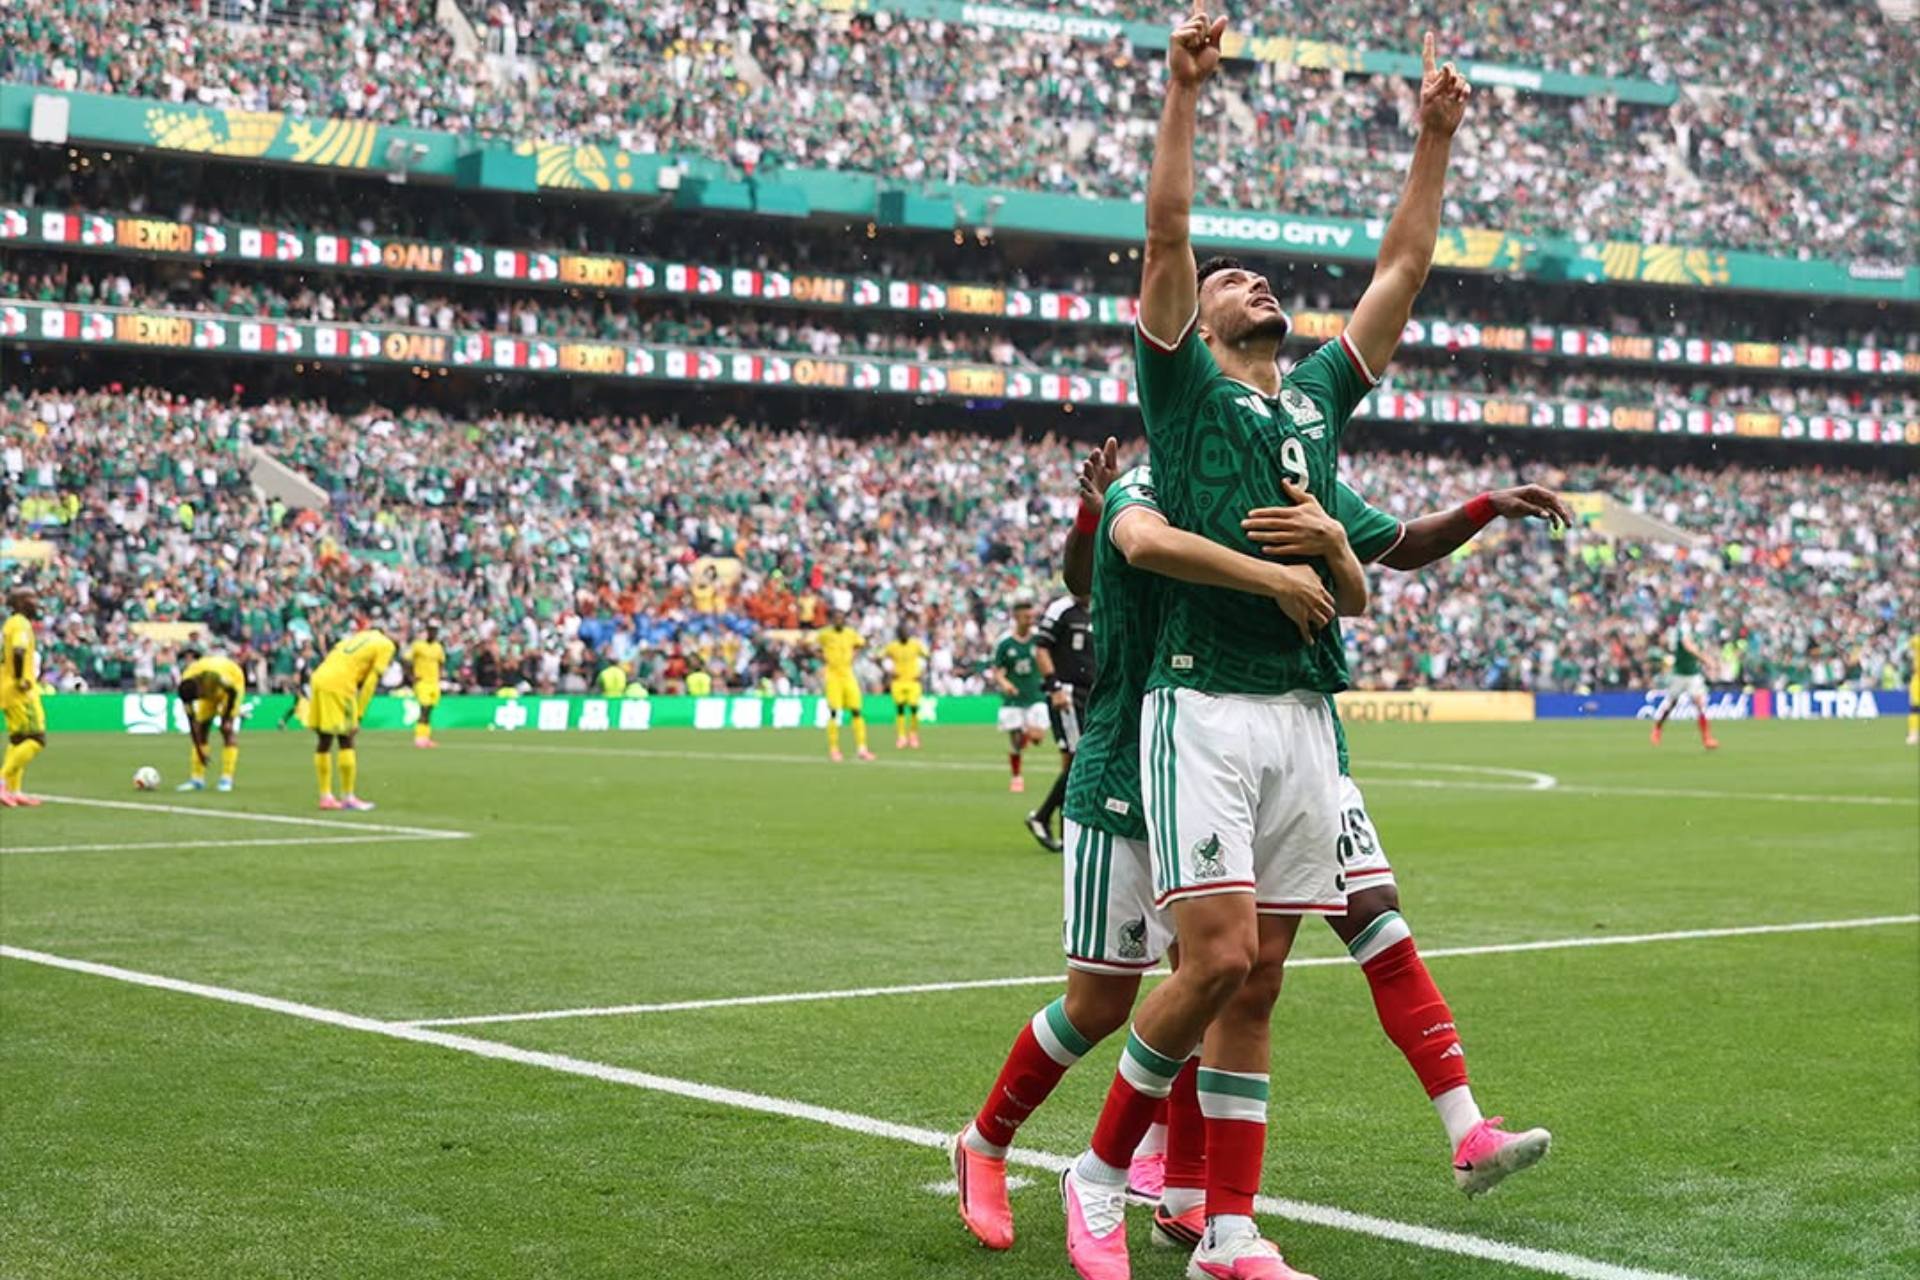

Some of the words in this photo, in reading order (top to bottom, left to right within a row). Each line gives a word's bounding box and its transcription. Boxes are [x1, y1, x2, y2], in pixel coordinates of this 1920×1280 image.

[1063, 16, 1122, 39] CITY
[116, 218, 193, 252] MEXICO
[1282, 222, 1352, 248] CITY
[1280, 436, 1309, 492] 9
[1383, 701, 1431, 720] CITY
[1775, 689, 1879, 718] ULTRA
